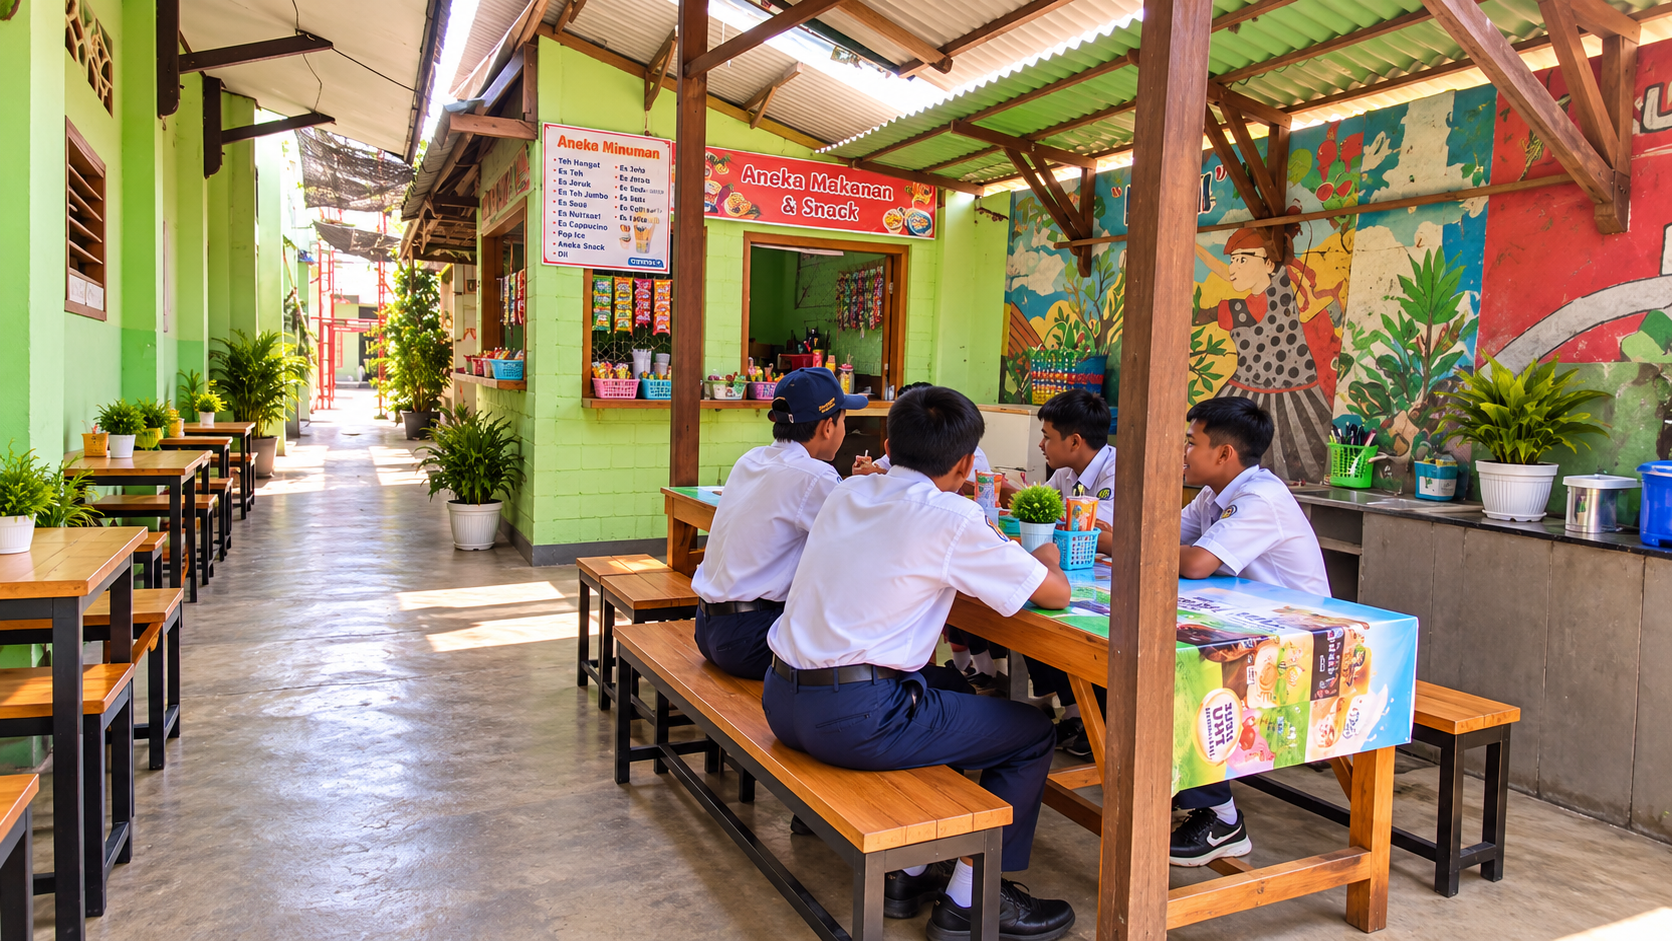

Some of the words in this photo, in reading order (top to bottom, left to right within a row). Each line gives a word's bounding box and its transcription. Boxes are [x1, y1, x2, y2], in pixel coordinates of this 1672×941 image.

[557, 135, 599, 152] Aneka
[602, 140, 660, 160] Minuman
[574, 159, 600, 169] Hangat
[741, 164, 804, 190] Aneka
[810, 172, 894, 201] Makanan
[584, 191, 609, 200] Jumbo
[781, 195, 797, 215] &
[802, 197, 859, 222] Snack
[558, 230, 573, 239] Pop
[583, 242, 605, 251] Snack
